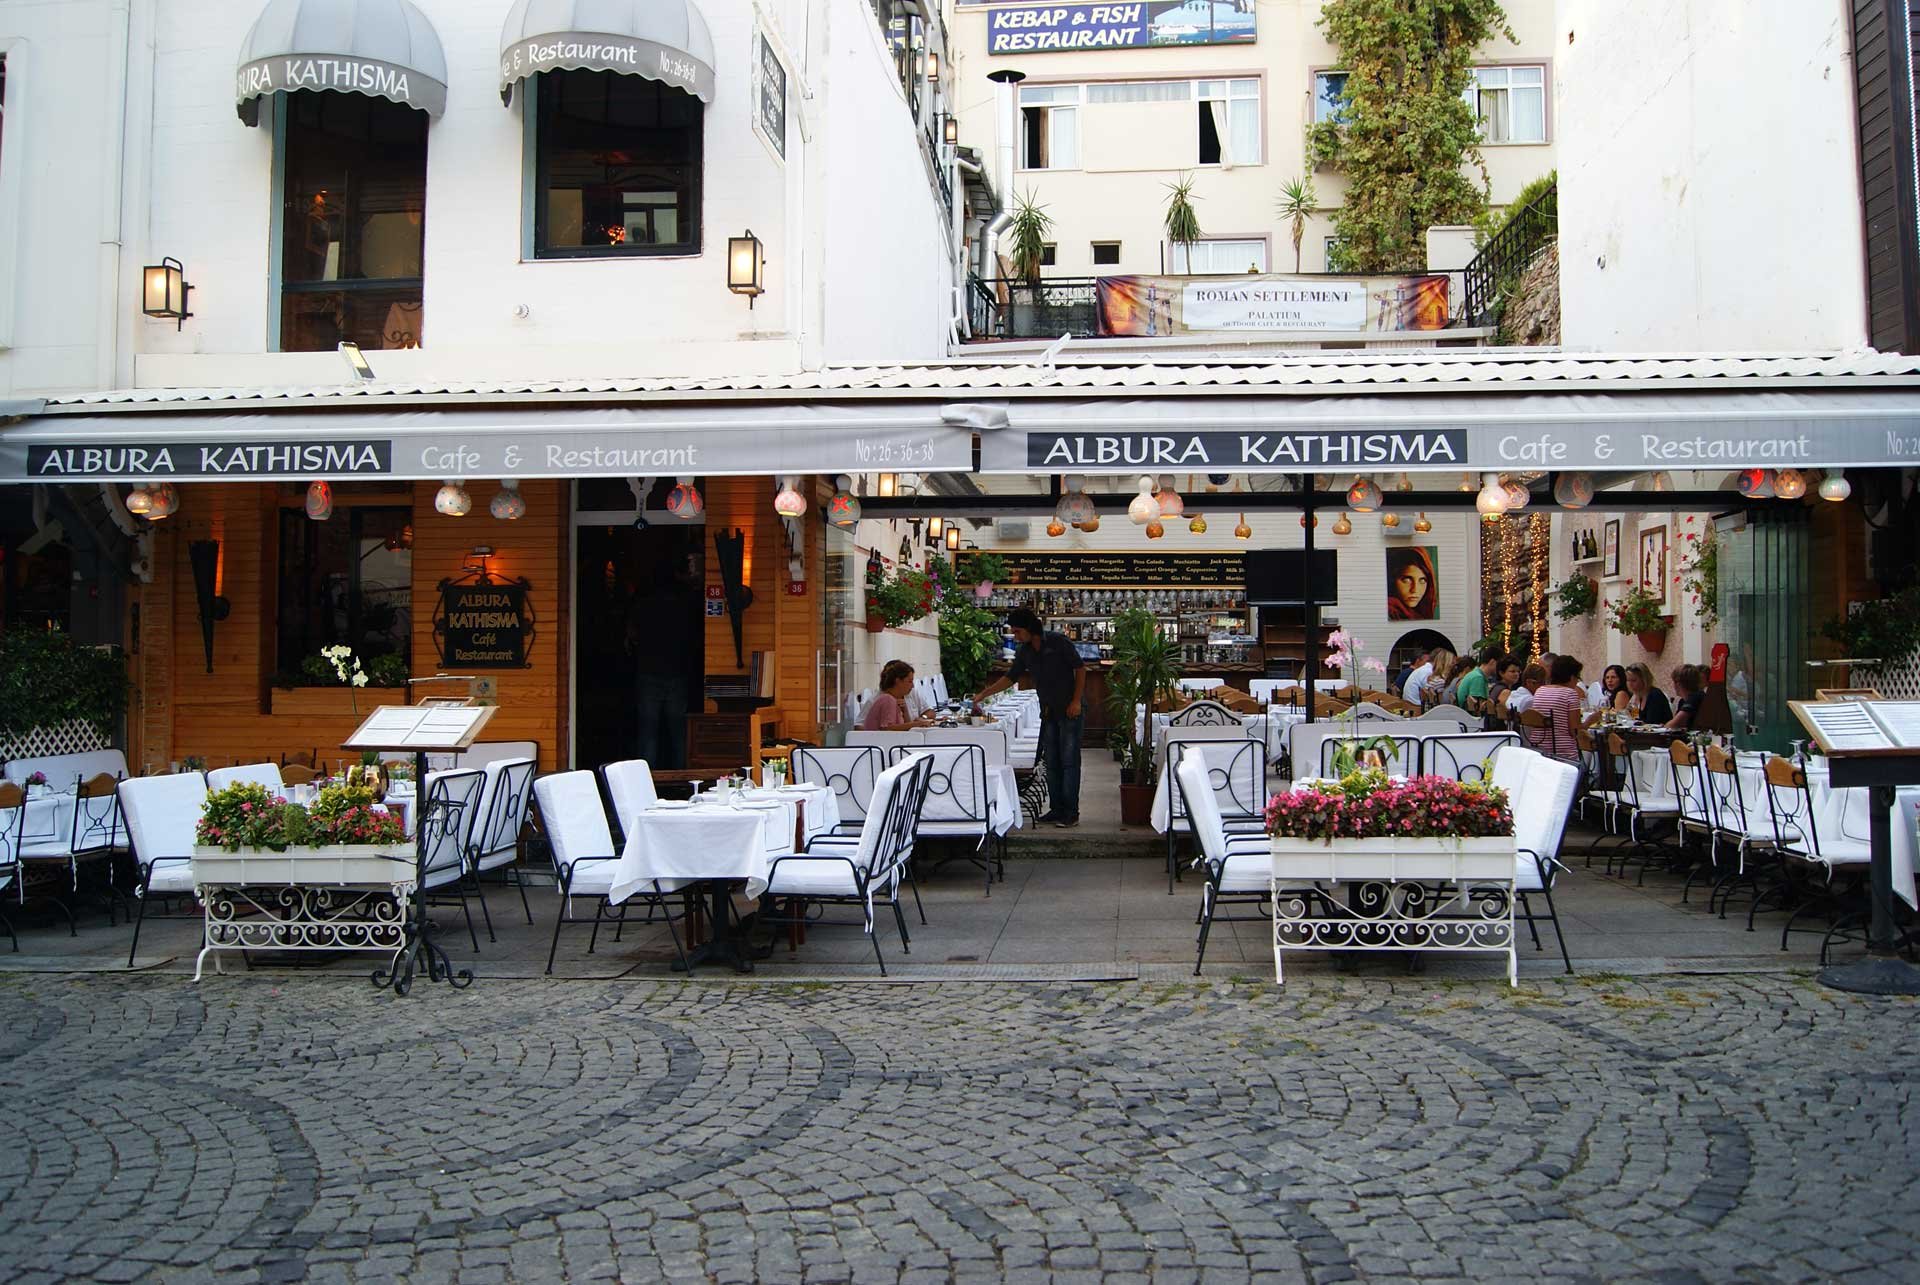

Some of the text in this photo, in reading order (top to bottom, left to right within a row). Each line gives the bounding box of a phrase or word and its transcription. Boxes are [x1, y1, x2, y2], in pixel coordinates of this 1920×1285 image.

[993, 4, 1142, 29] KEBAP & FISH
[993, 27, 1141, 51] RESTAURANT
[528, 40, 638, 64] Restaurant
[285, 59, 410, 100] KATHISMA
[1196, 290, 1352, 302] ROMAN SETTLEMENT
[1248, 311, 1301, 320] PALATIUM
[40, 444, 382, 474] ALBURA KATHISMA
[421, 443, 698, 473] Cafe & Restaurant
[1043, 433, 1457, 465] ALBURA KATHISMA
[1498, 433, 1811, 465] Cafe & Restaurant
[1210, 558, 1222, 566] Jack
[457, 594, 512, 608] ALBURA
[448, 612, 520, 629] KATHISMA
[471, 633, 497, 648] Café
[455, 649, 513, 661] Restaurant
